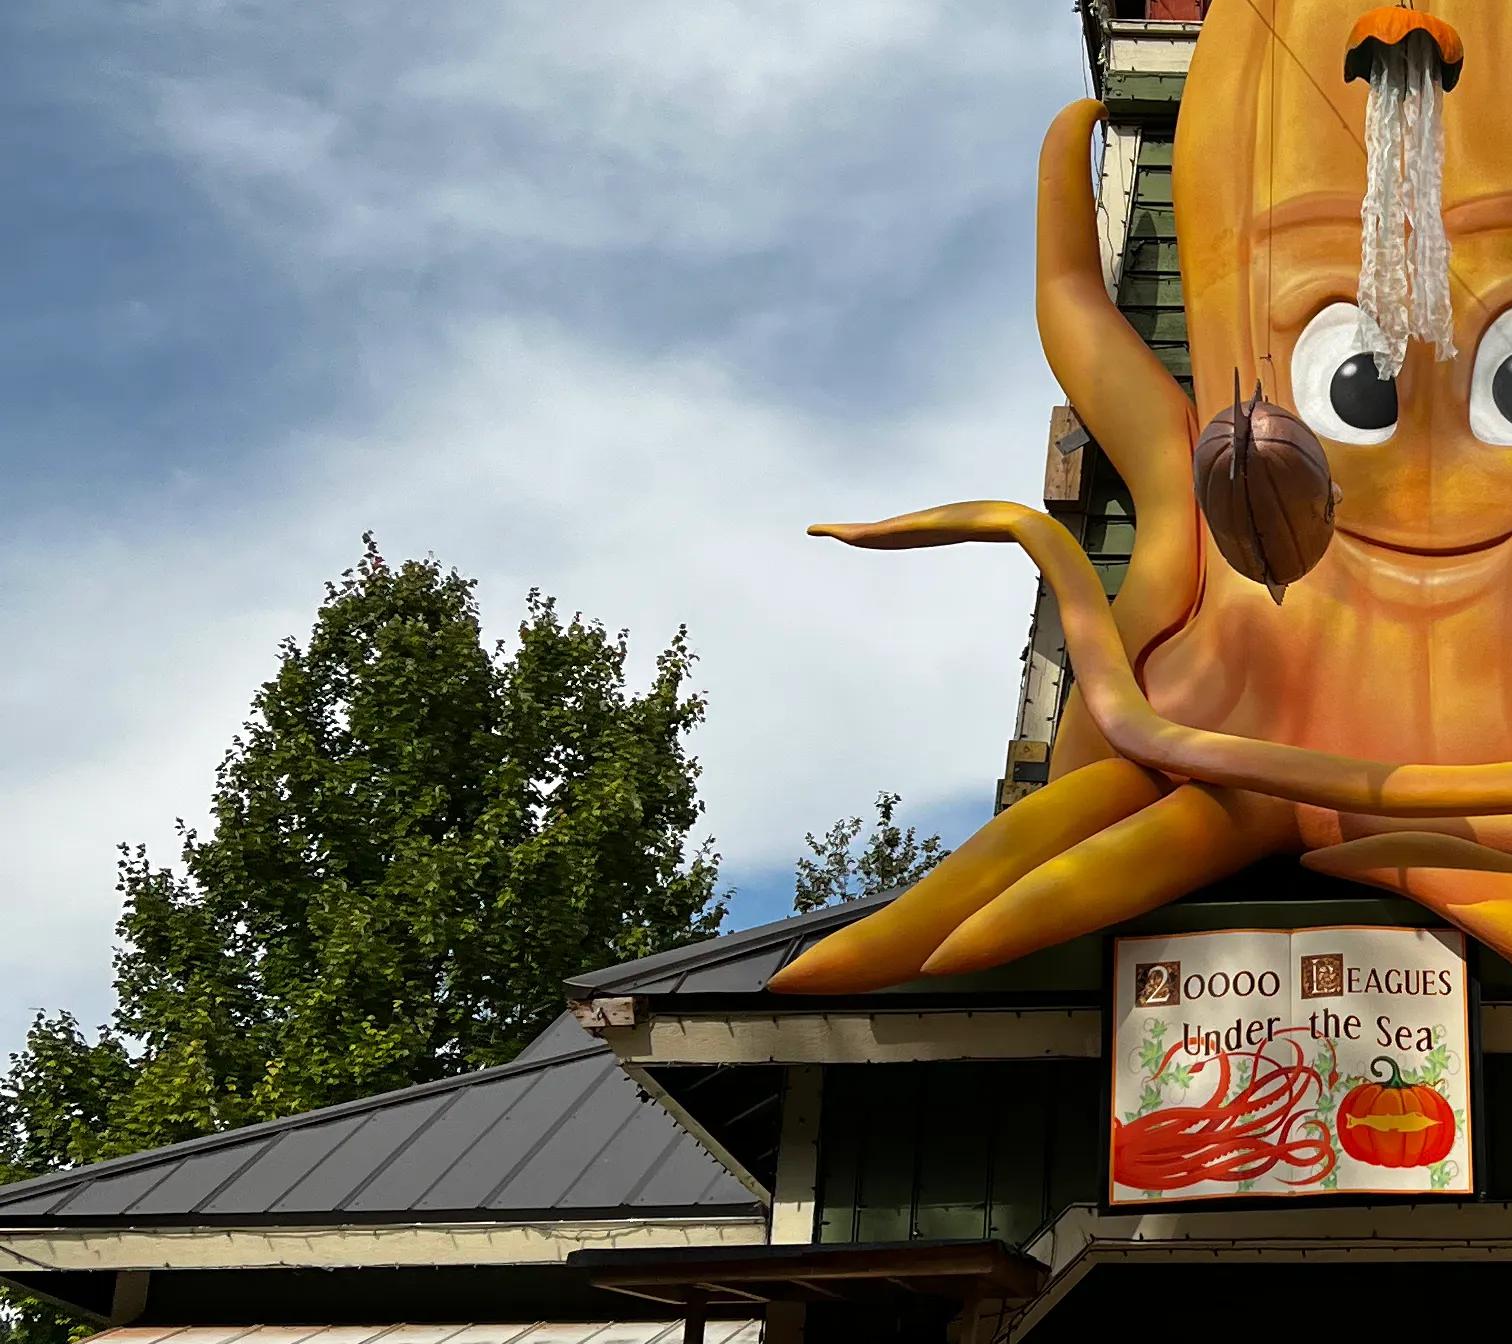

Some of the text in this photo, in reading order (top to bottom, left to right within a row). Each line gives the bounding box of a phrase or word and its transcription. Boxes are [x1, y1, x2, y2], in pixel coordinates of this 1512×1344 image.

[1142, 958, 1452, 1005] 20000 LEAGUES
[1182, 1007, 1435, 1056] Under the Sea
